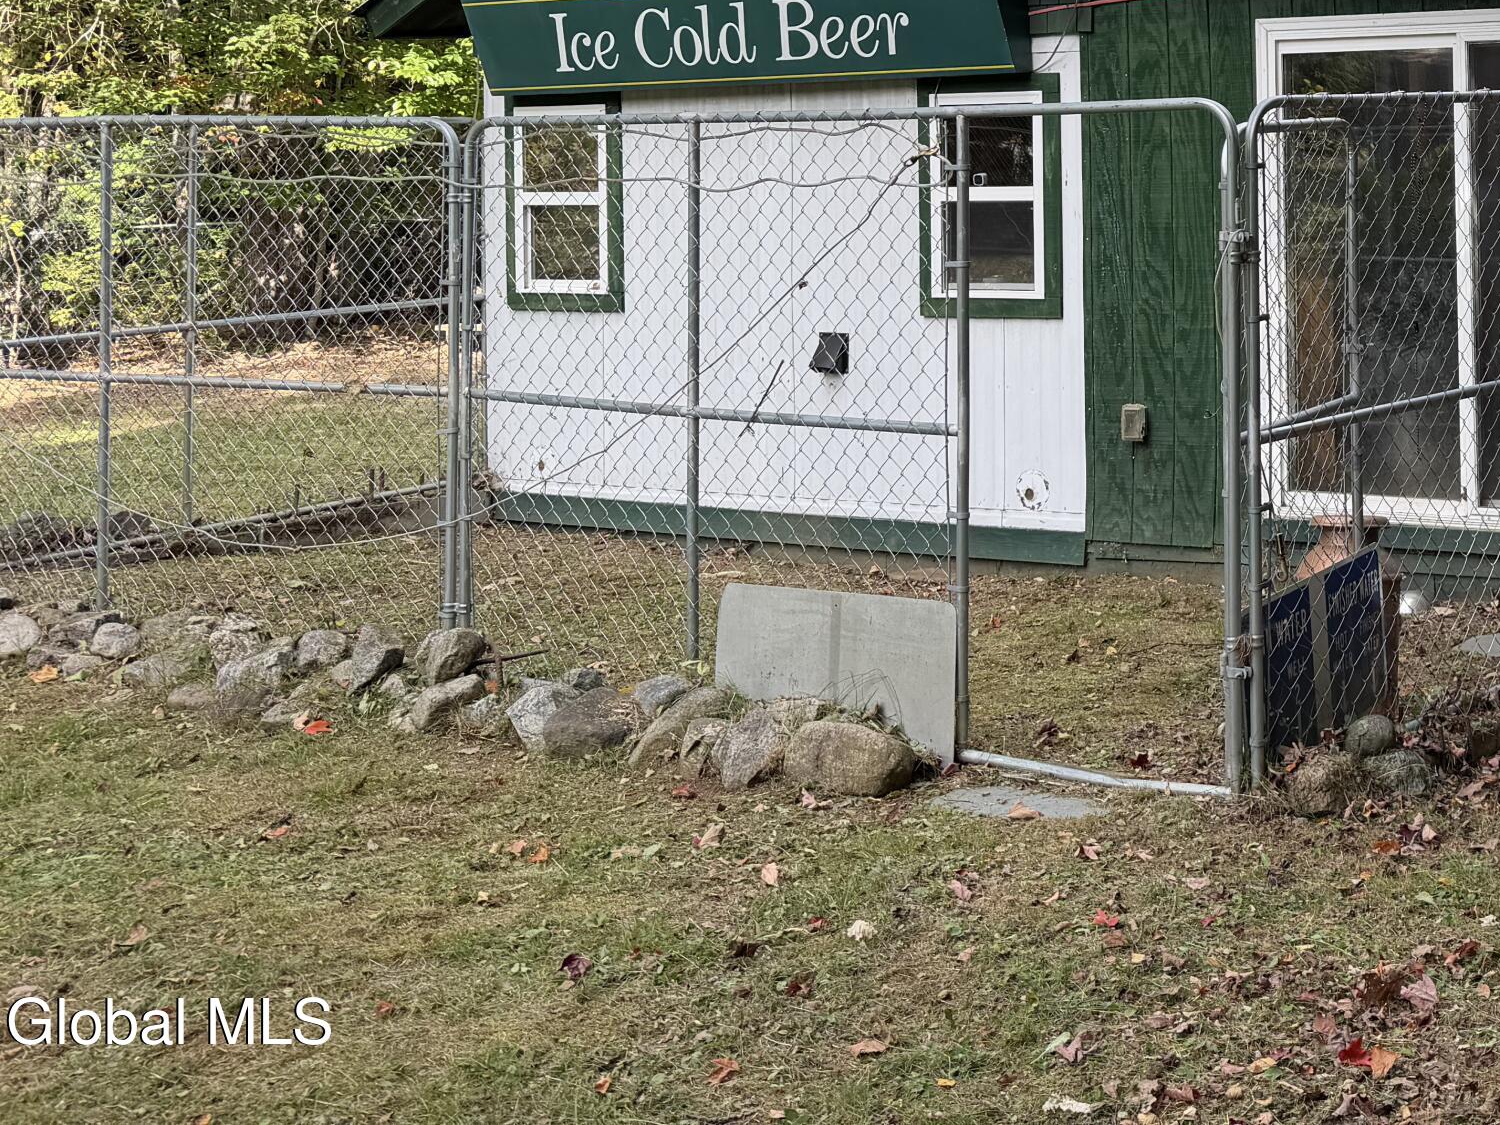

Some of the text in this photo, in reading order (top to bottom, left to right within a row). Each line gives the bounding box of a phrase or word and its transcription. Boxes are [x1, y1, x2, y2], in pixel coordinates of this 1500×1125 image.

[548, 12, 620, 73] Ice
[634, 0, 757, 70] Cold
[1360, 568, 1380, 602] WATER
[1275, 608, 1309, 648] WATER
